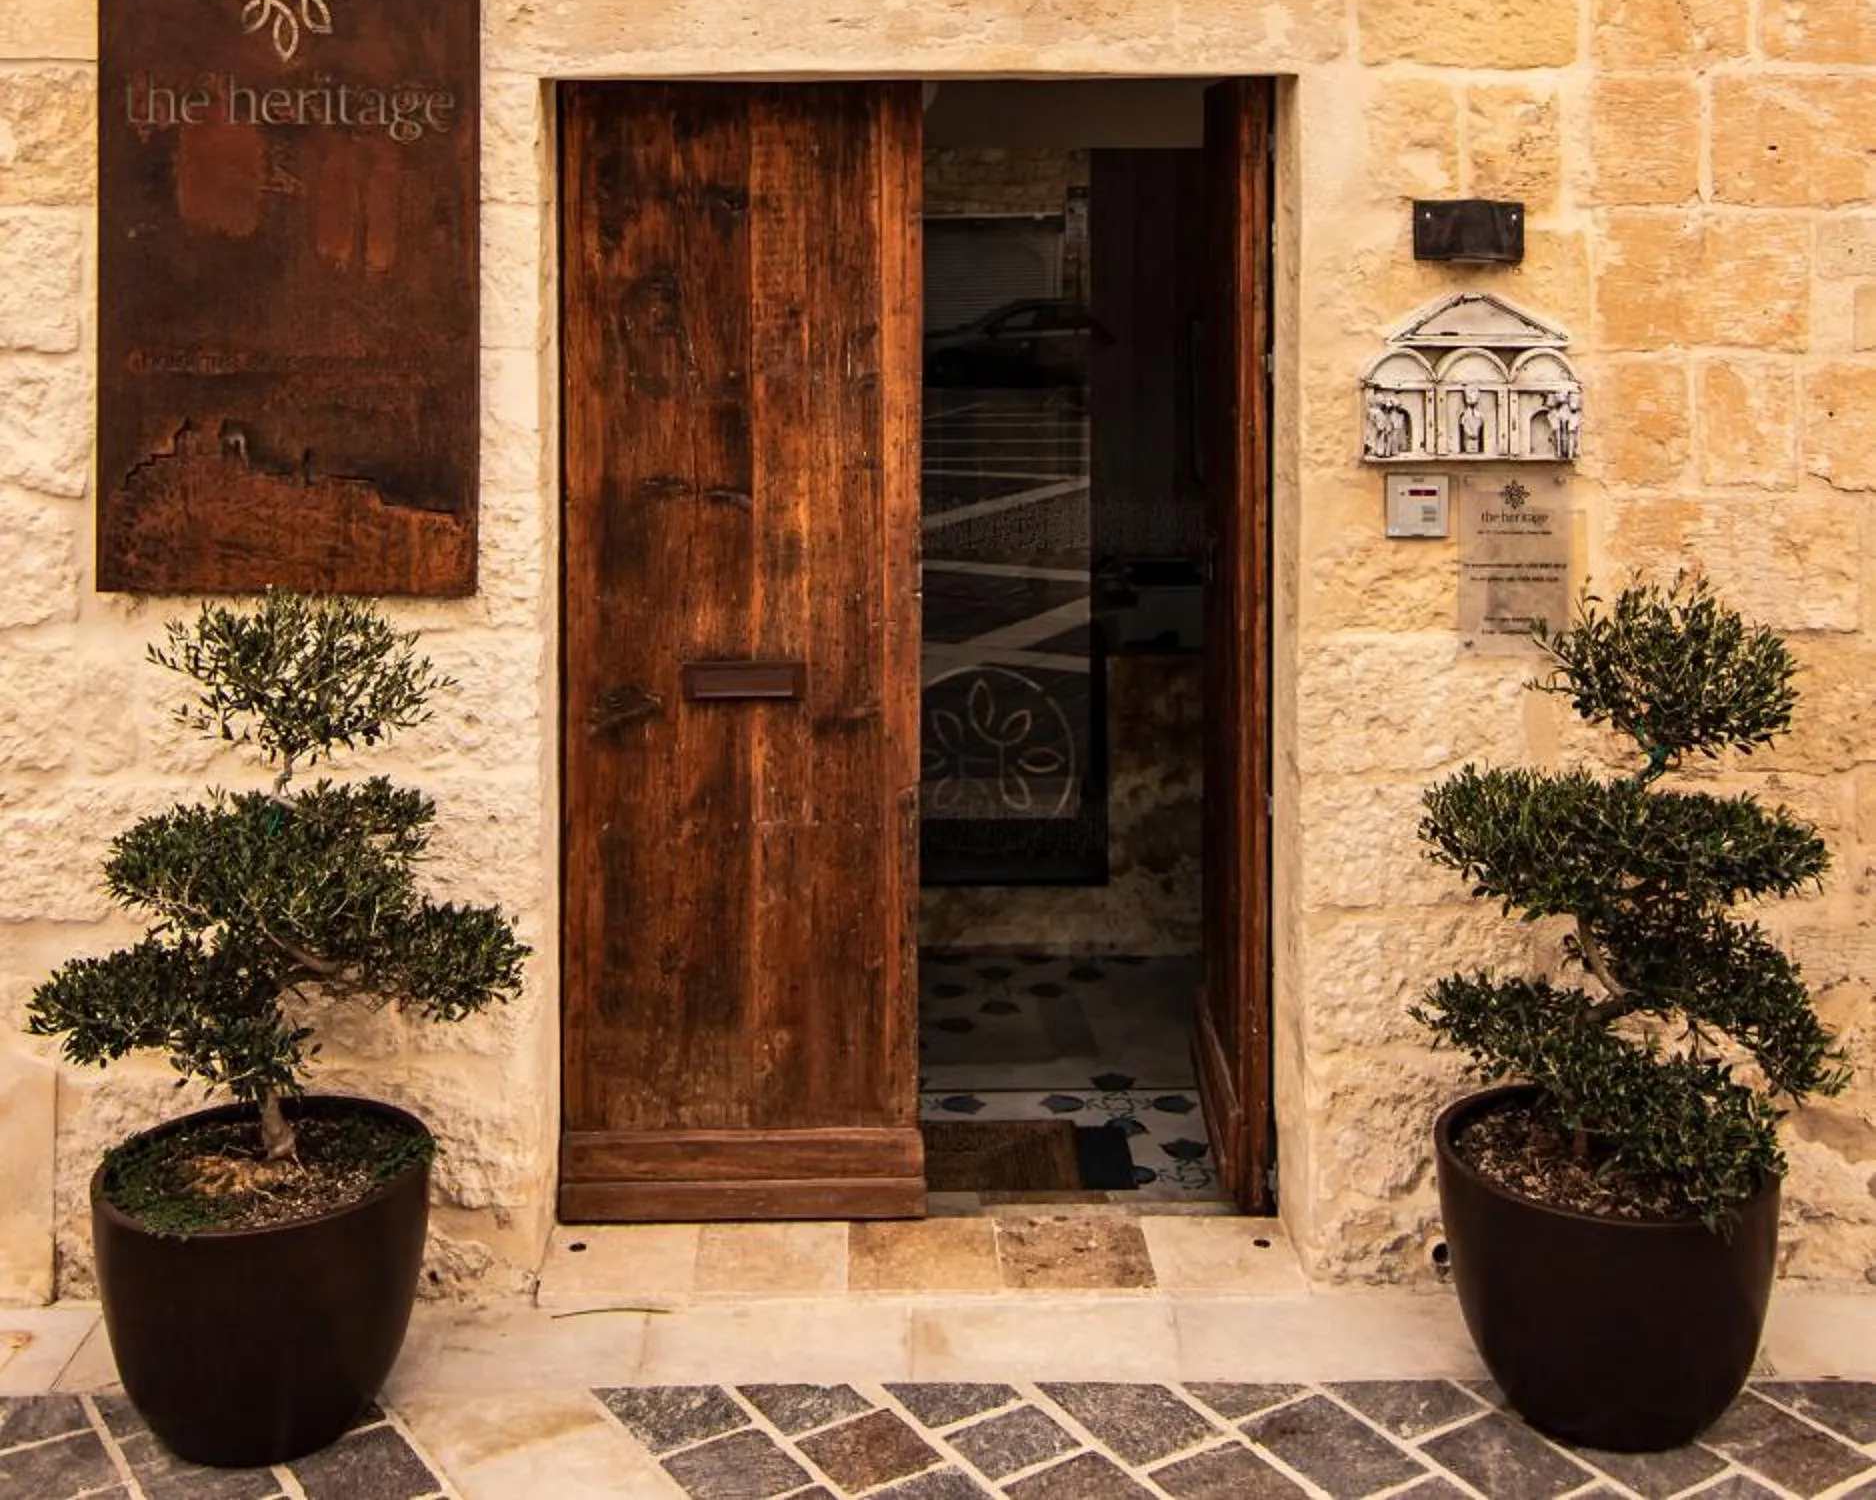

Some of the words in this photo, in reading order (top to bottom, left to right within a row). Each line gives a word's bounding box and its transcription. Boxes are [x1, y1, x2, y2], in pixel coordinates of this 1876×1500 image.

[125, 72, 211, 126] the
[228, 71, 456, 143] heritage
[1481, 510, 1499, 523] the
[1501, 510, 1549, 527] heritage
